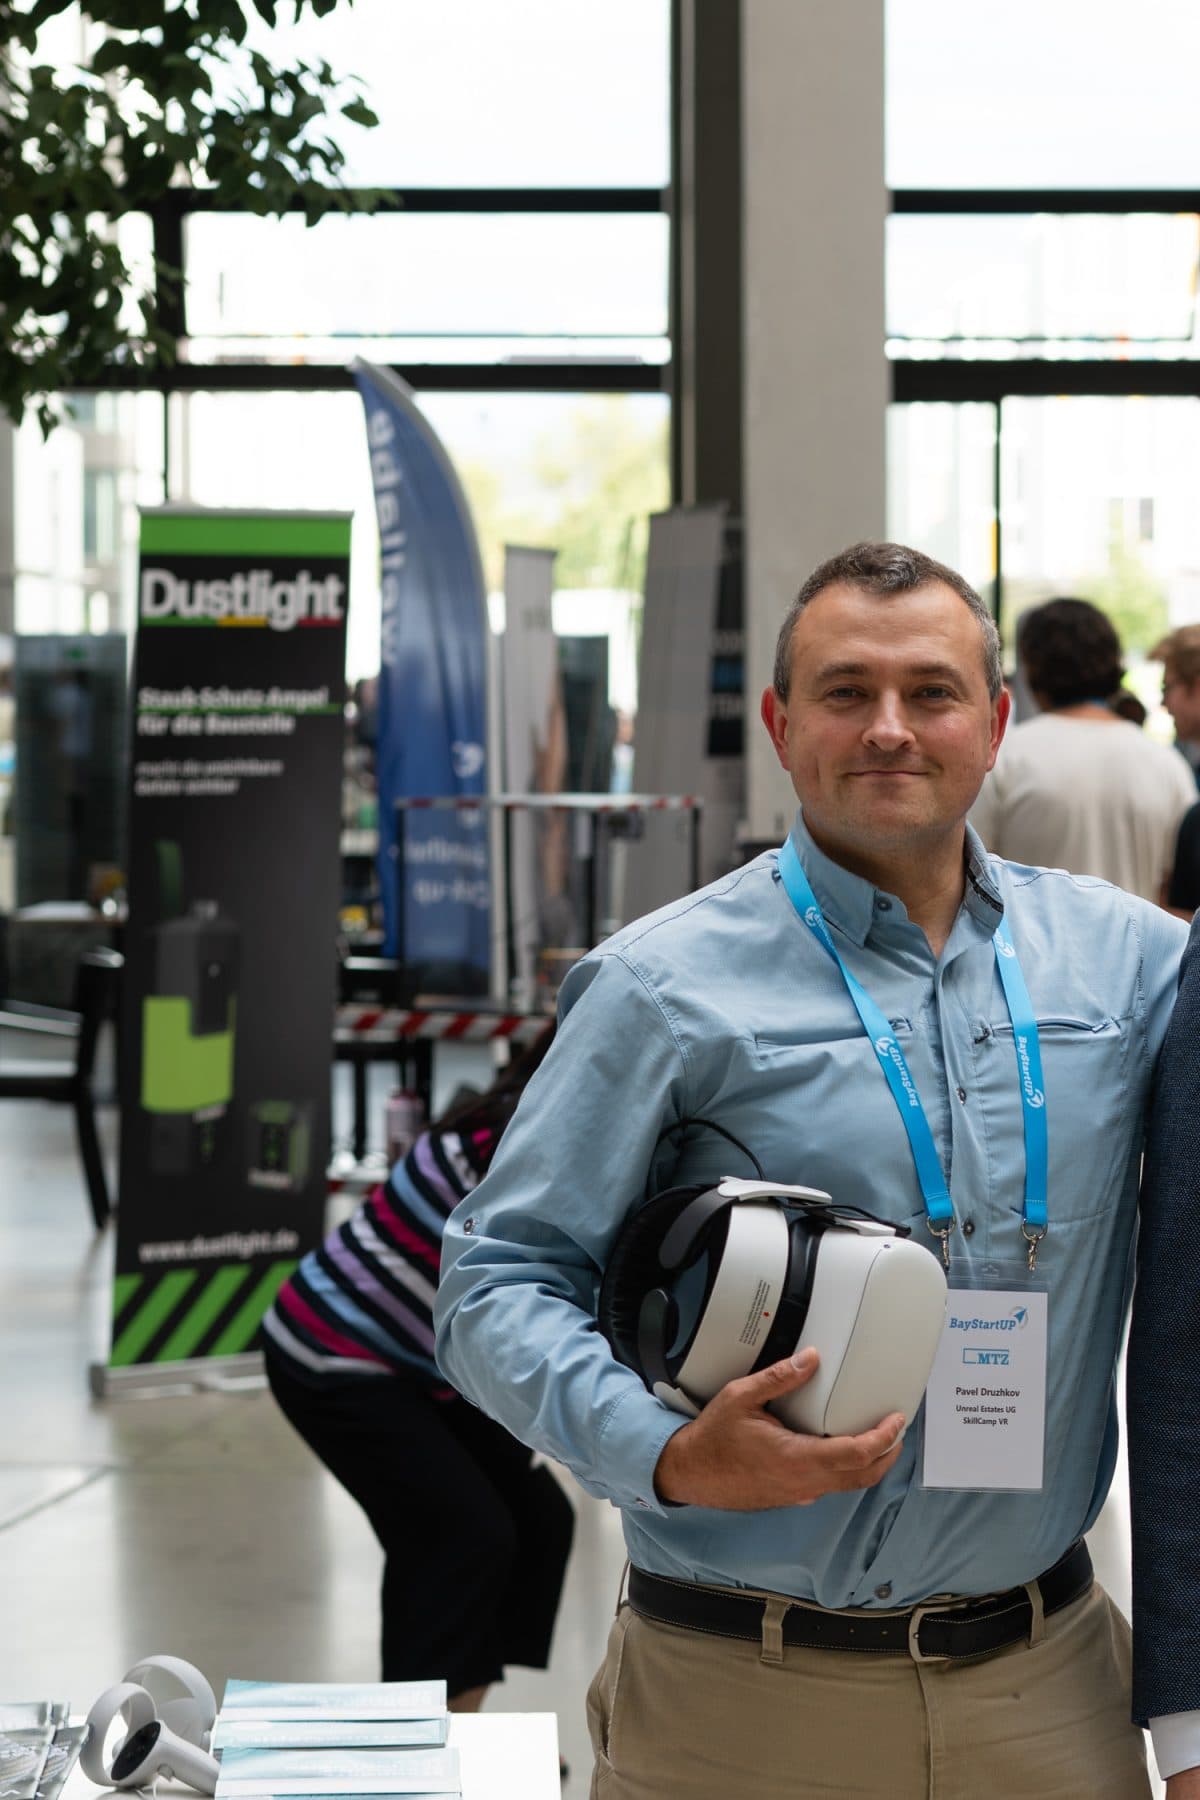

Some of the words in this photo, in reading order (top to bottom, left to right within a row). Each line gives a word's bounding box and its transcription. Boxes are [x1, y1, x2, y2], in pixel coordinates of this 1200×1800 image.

[140, 568, 344, 631] Dustlight
[1017, 1035, 1034, 1097] BayStartUP
[949, 1317, 1016, 1331] BayStartUP
[977, 1352, 1009, 1365] MTZ
[956, 1387, 978, 1397] Pavel
[980, 1388, 1020, 1397] Druzhkov
[956, 1404, 979, 1413] Unreal
[980, 1405, 1004, 1413] Estates
[1005, 1405, 1016, 1414] UG
[963, 1416, 997, 1427] SkillCamp
[998, 1417, 1009, 1426] VR
